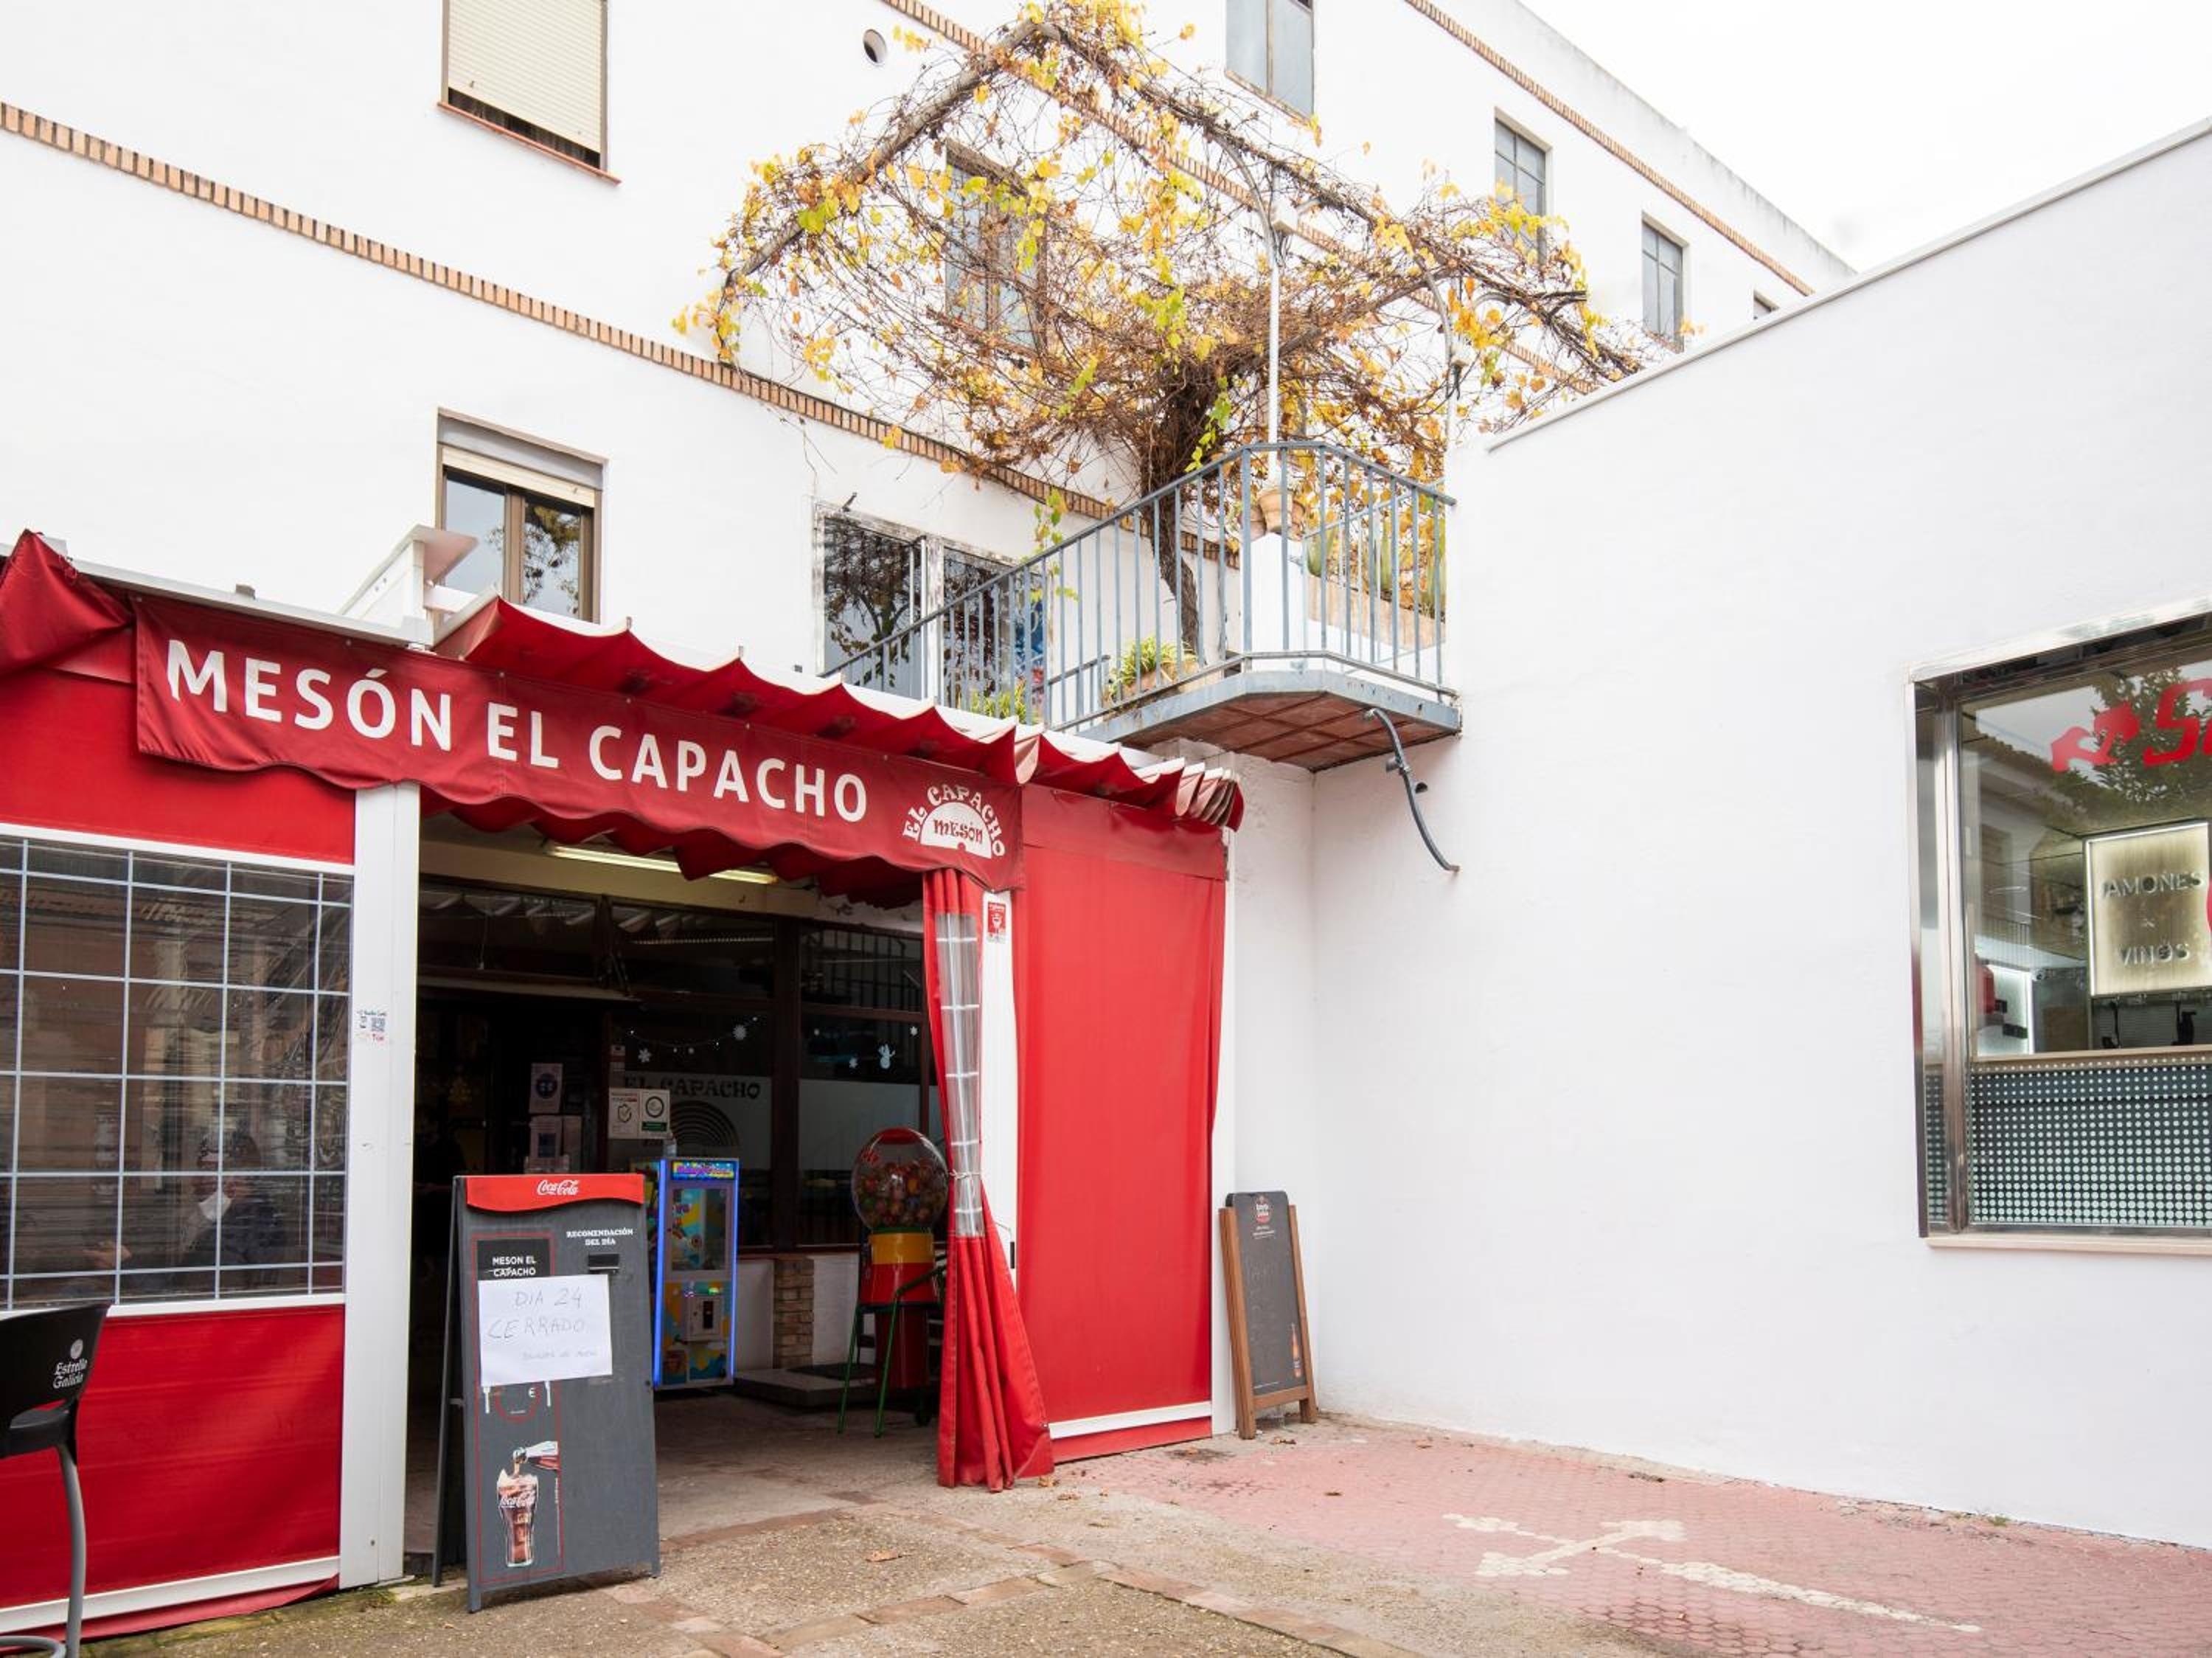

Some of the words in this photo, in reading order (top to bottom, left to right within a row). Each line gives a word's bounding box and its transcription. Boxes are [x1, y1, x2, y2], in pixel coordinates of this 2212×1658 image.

[167, 639, 452, 751] MESÓN
[487, 701, 560, 769] EL
[588, 725, 867, 823] CAPACHO
[902, 806, 928, 842] EL
[927, 784, 1005, 856] CAPACHO
[2118, 943, 2191, 965] VINOS
[493, 1255, 524, 1266] MESON
[526, 1255, 537, 1265] EL
[493, 1266, 537, 1277] CAPACHO
[554, 1286, 582, 1308] 24
